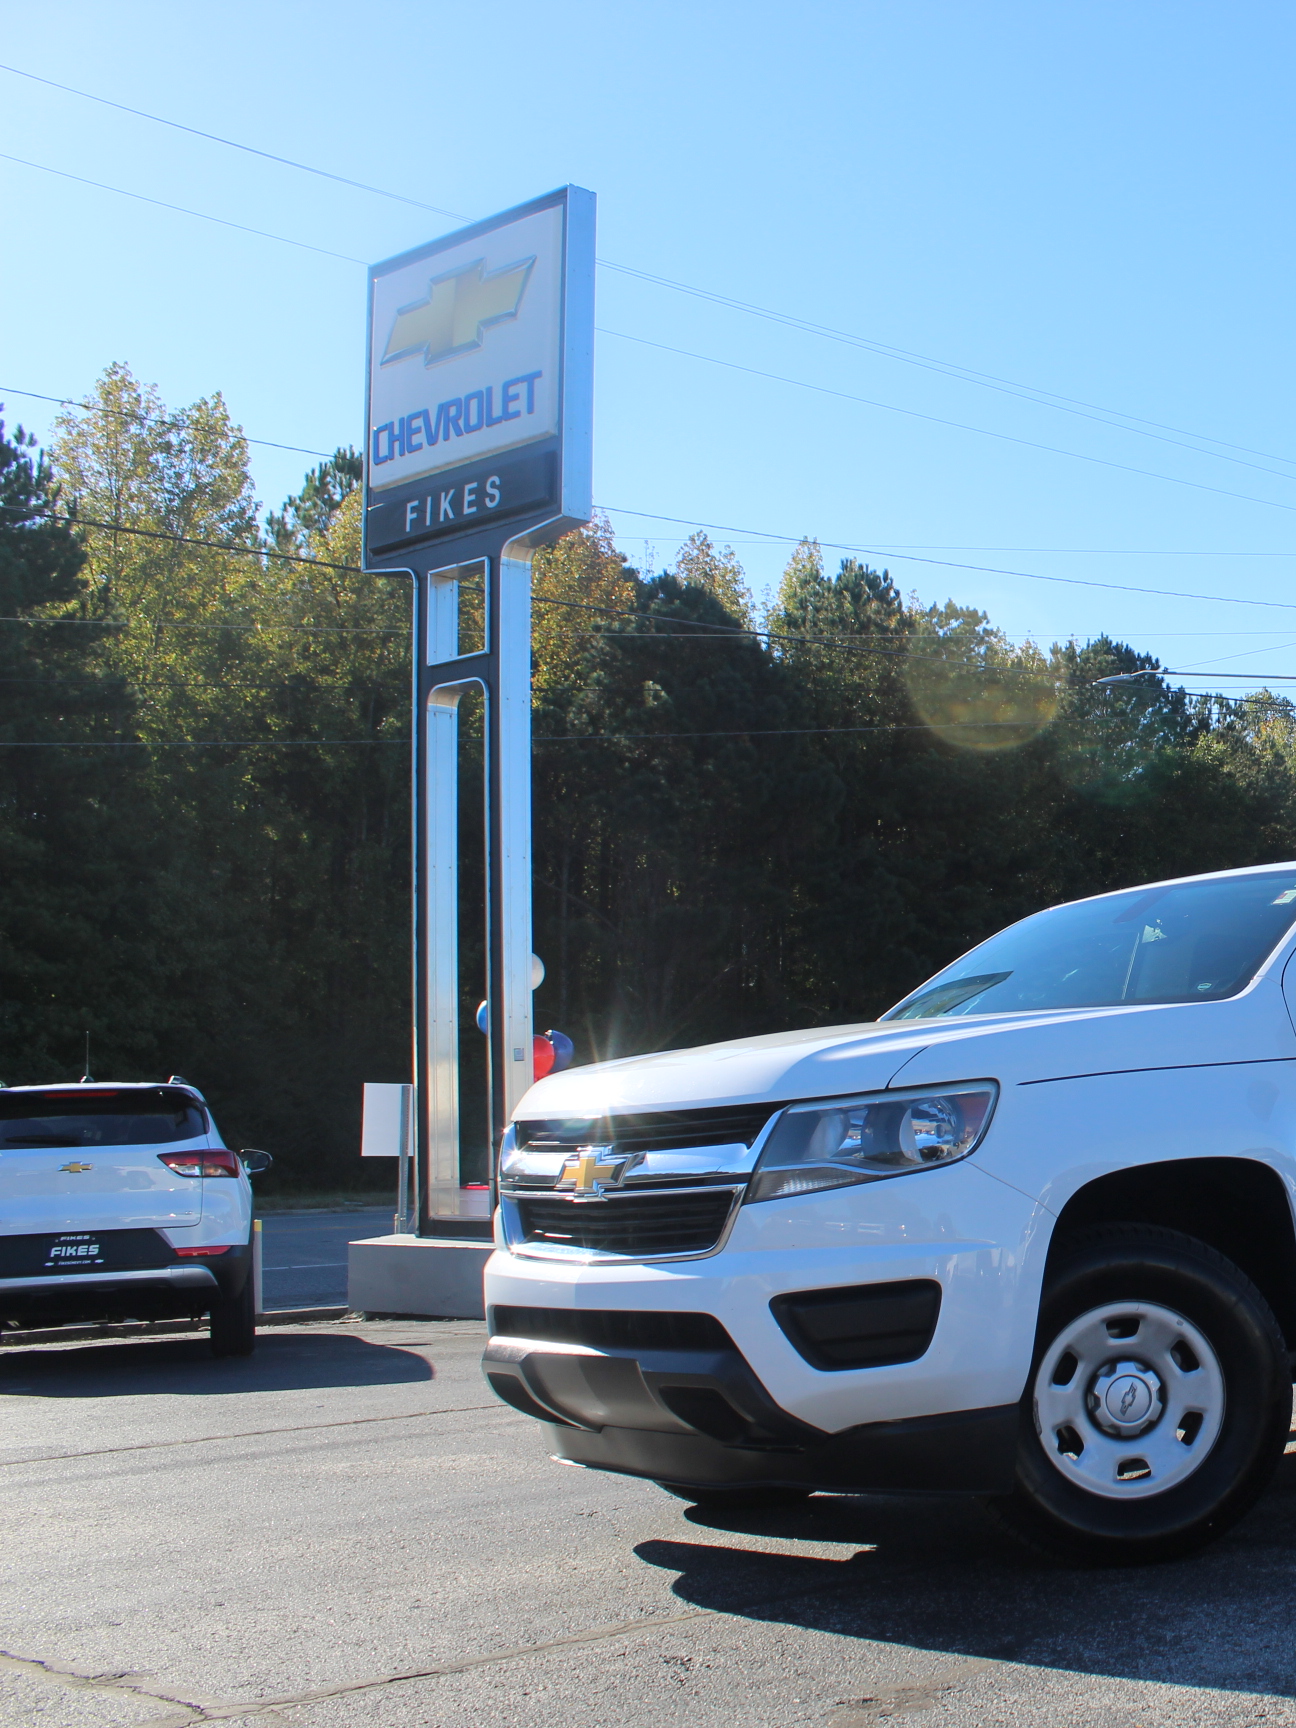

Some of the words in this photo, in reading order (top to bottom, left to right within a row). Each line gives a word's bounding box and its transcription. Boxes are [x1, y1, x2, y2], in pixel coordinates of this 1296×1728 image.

[373, 370, 542, 465] CHEVROLET
[406, 475, 501, 533] FIKES
[50, 1244, 99, 1258] FIKES
